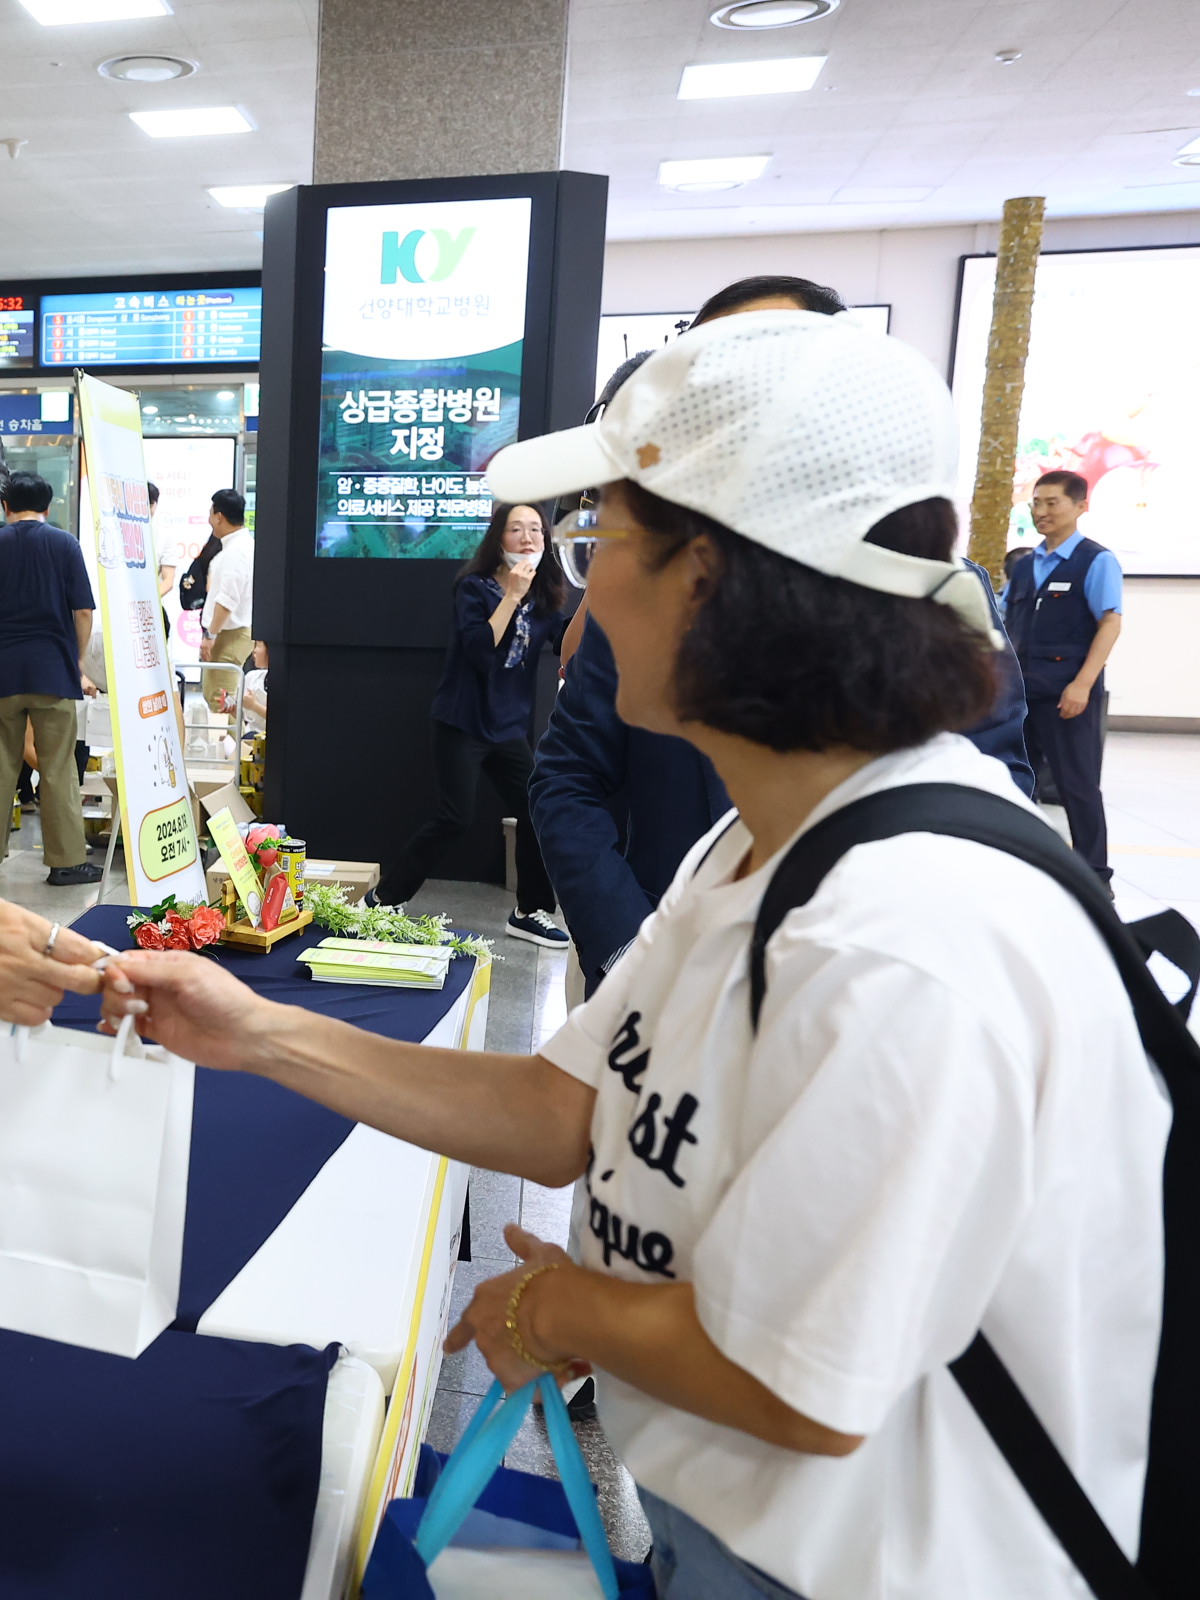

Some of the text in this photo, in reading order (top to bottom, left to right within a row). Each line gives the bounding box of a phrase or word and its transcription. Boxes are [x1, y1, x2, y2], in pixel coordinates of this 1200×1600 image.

[381, 227, 479, 284] KY
[339, 387, 500, 424] 상급종합병원
[8, 419, 42, 432] 승차홈
[389, 426, 445, 461] 지정
[421, 477, 464, 495] 난이도
[337, 499, 492, 517] 의료서비스 제공 전문병원
[161, 842, 176, 862] 오전
